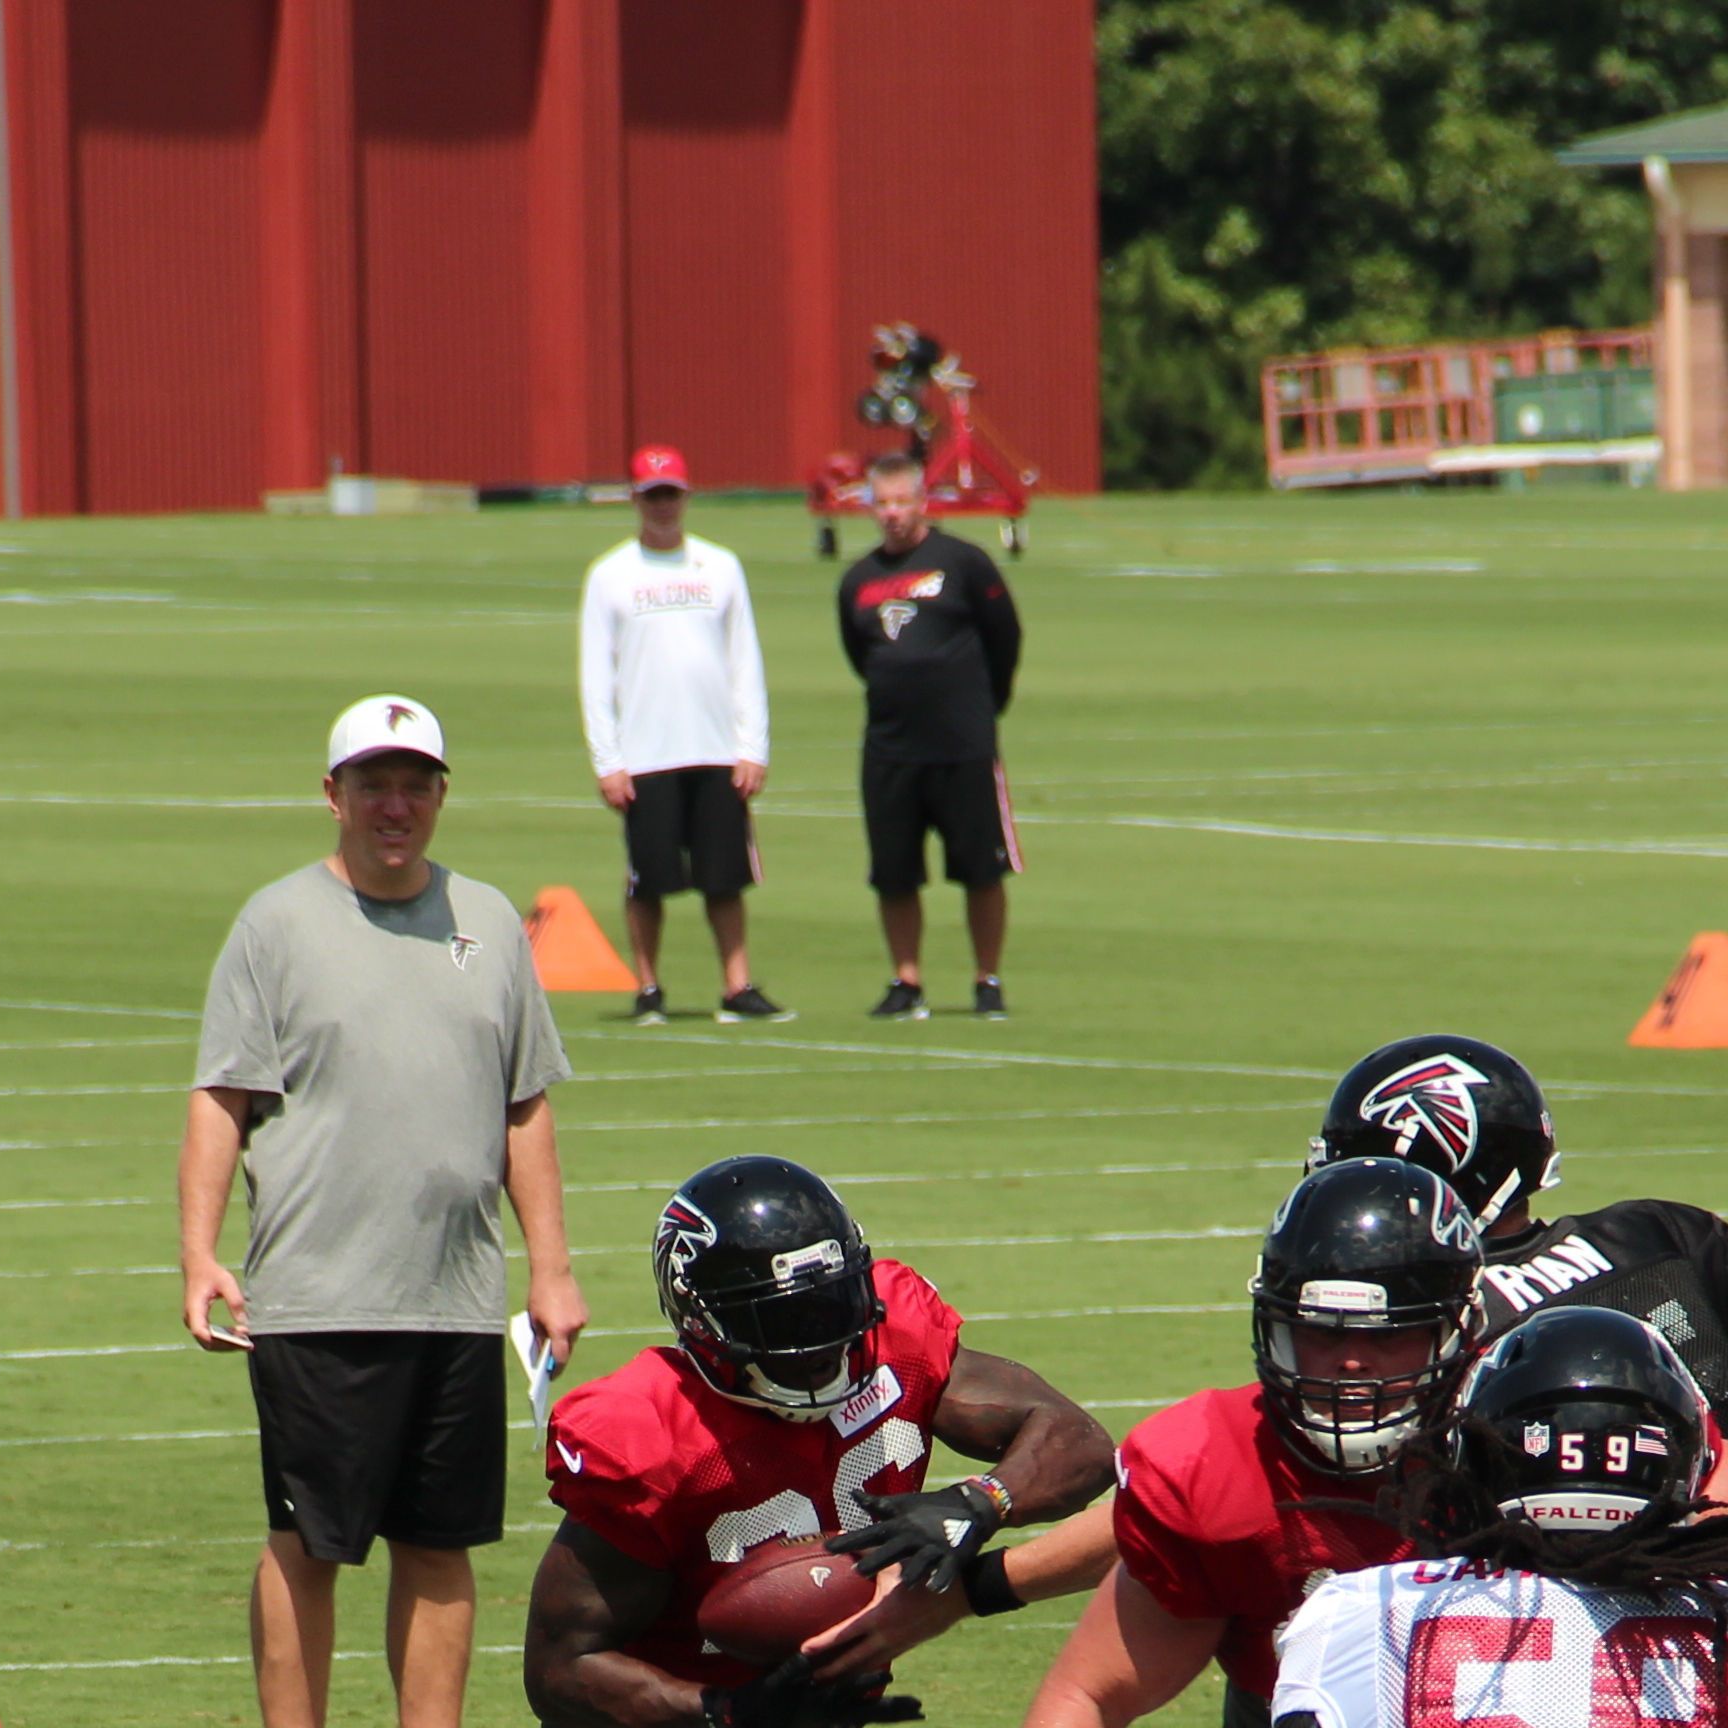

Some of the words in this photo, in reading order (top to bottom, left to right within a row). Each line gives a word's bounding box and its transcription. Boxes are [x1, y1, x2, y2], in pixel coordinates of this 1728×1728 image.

[1484, 1234, 1614, 1312] RYAN
[839, 1379, 890, 1425] xfinity
[1527, 1436, 1547, 1451] NFL
[1560, 1434, 1630, 1473] 59
[1532, 1507, 1636, 1523] FALCON
